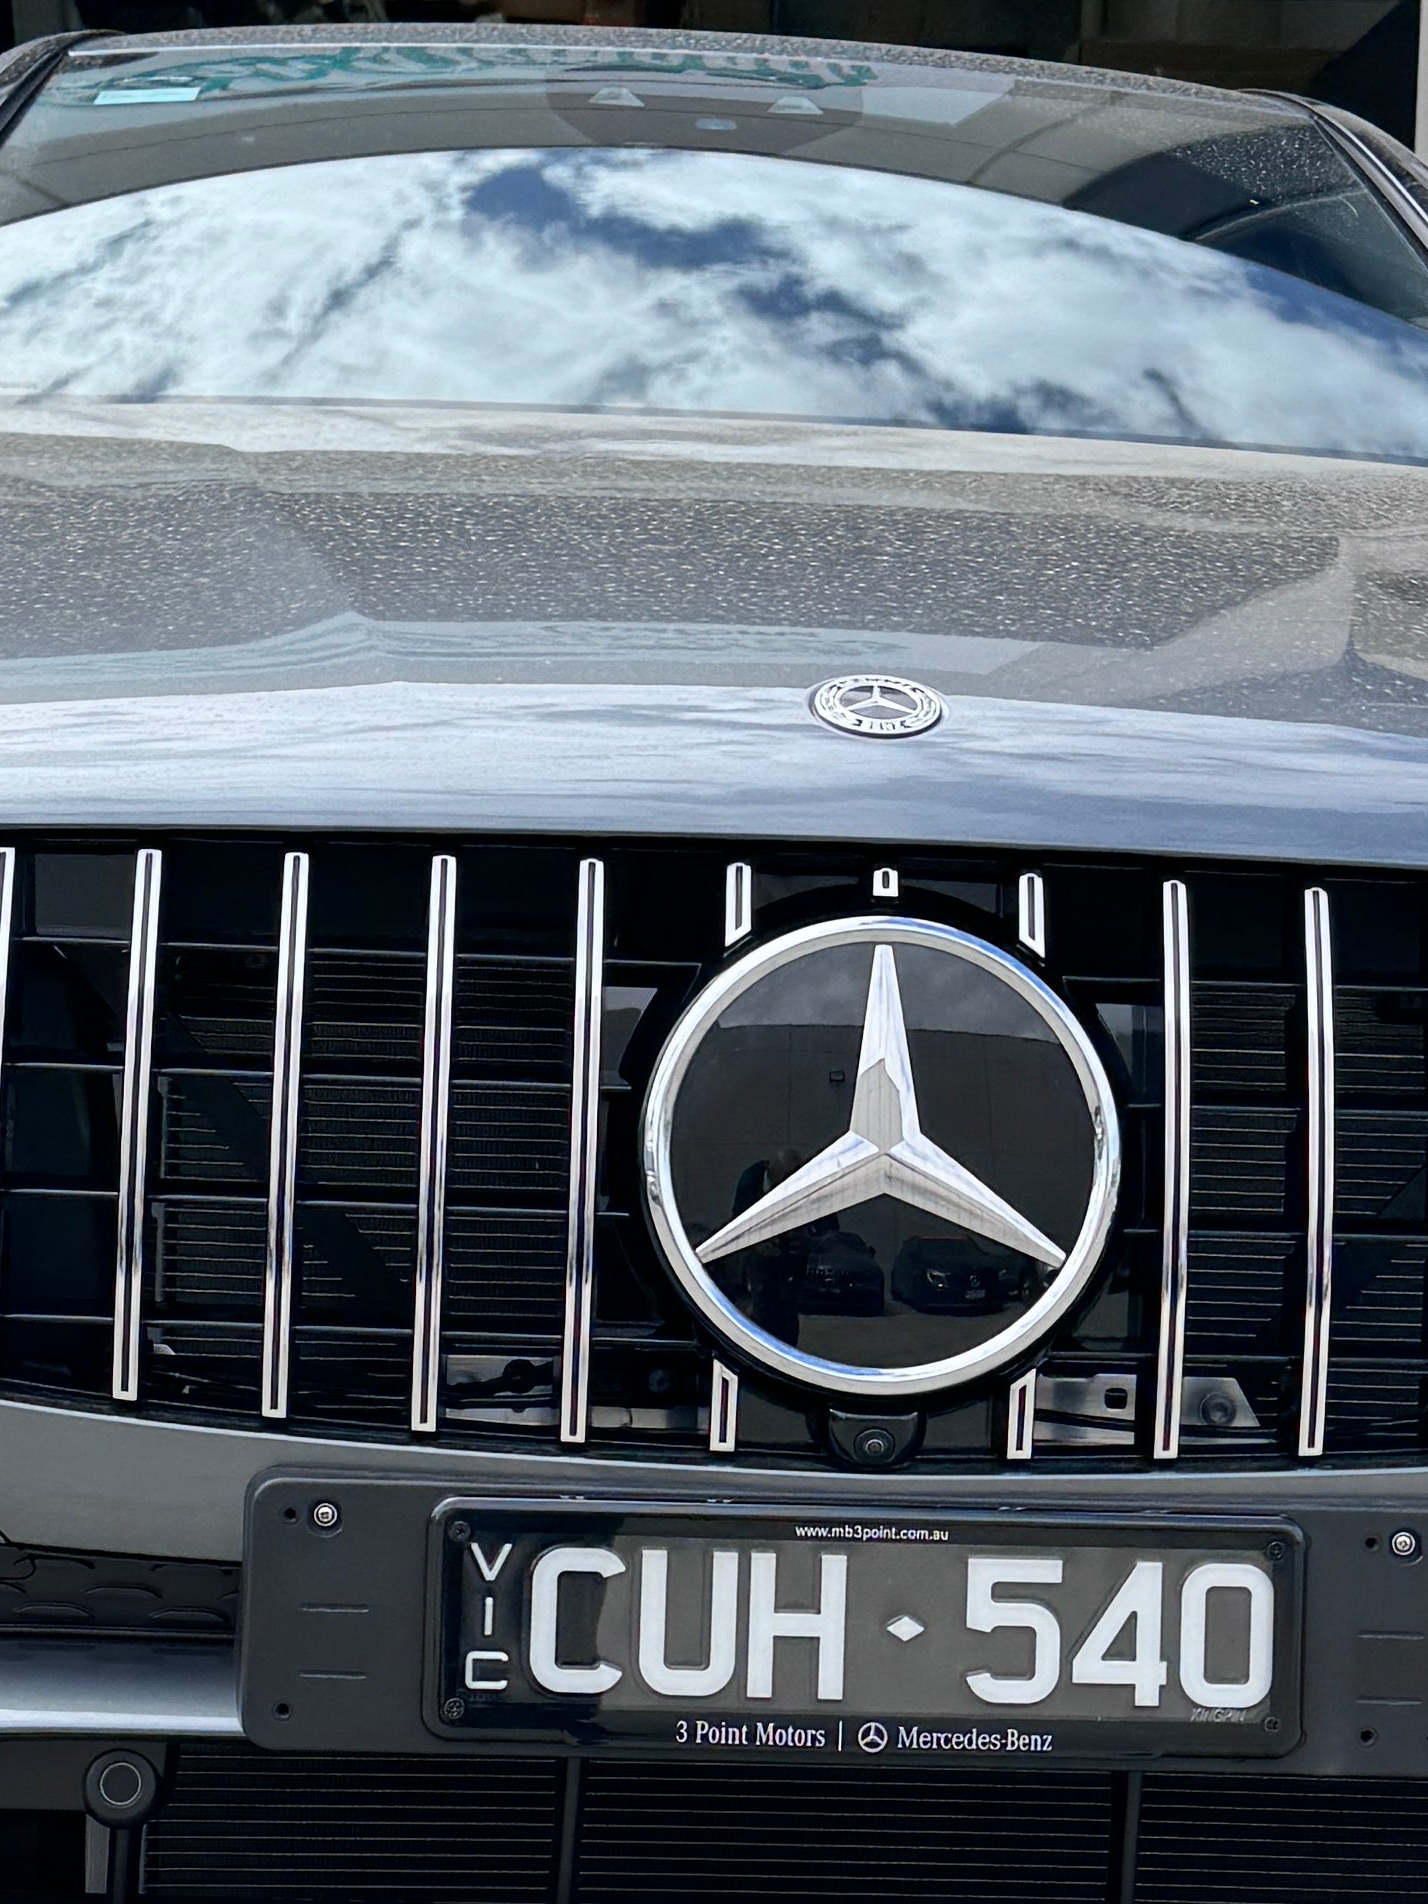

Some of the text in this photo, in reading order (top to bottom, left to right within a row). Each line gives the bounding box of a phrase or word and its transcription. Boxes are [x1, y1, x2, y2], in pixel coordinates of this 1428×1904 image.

[795, 1524, 949, 1542] www.mb3point.com.au
[464, 1542, 513, 1690] VIC
[529, 1547, 1276, 1709] CUH 540
[676, 1720, 1053, 1752] 3 Point Motors Mercedes-Benz
